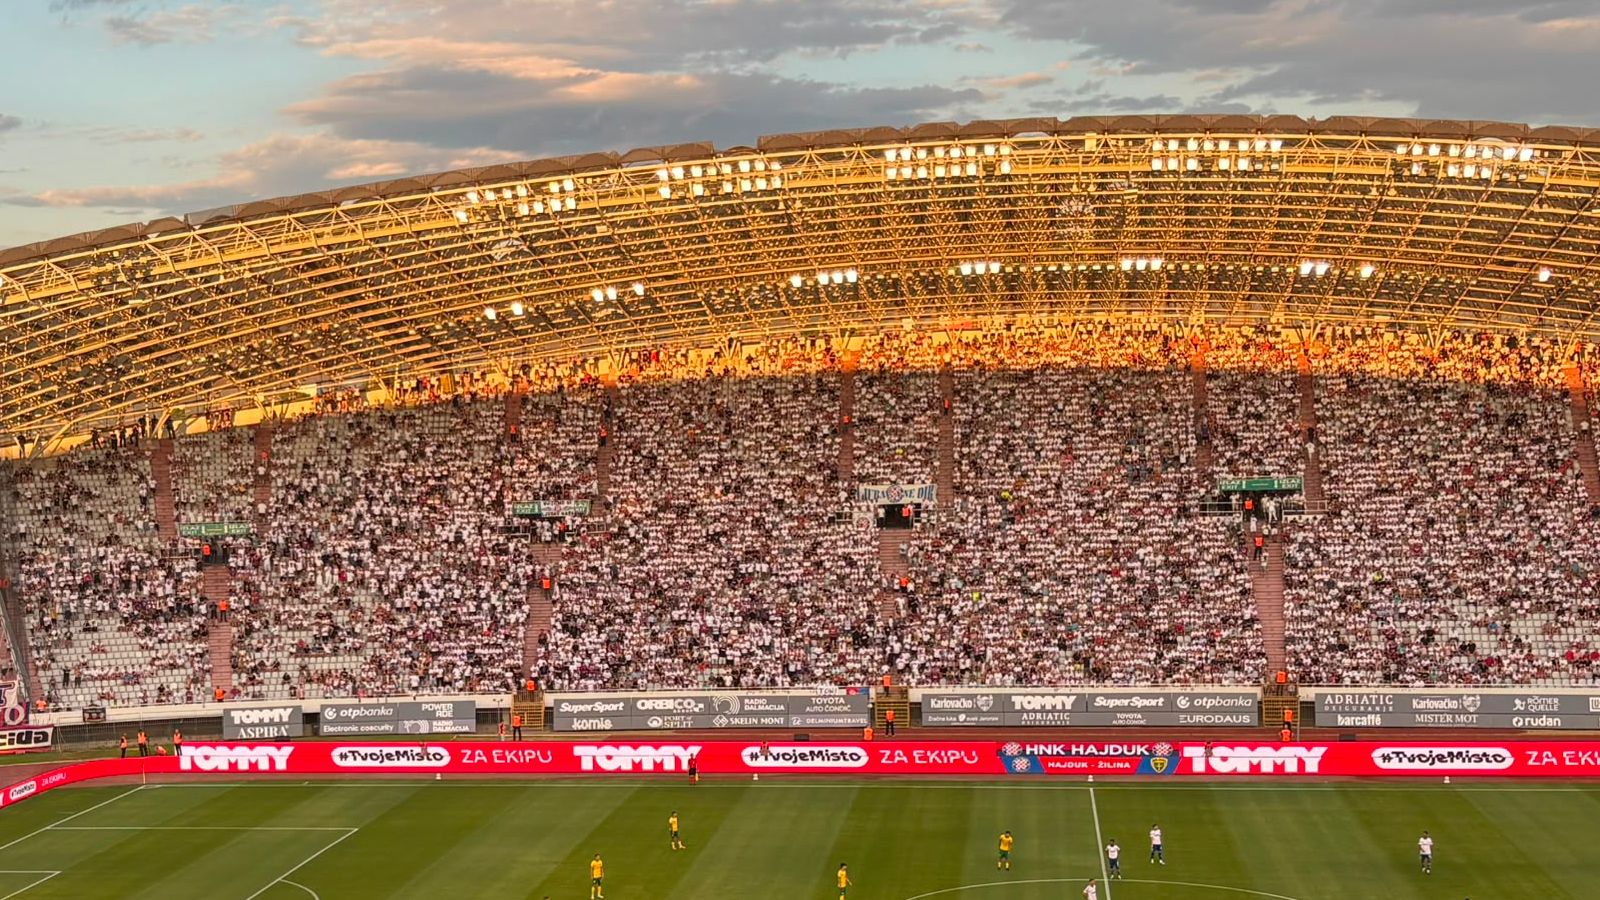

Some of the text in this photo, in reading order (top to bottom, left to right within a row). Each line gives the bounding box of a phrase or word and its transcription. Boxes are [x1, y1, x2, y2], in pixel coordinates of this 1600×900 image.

[636, 698, 696, 710] ORBICO
[1011, 696, 1077, 710] TOMMY
[1094, 696, 1165, 708] SuperSport
[1194, 696, 1252, 708] otpbanka
[1324, 694, 1394, 704] ADRIATIC
[560, 702, 625, 714] SuperSport
[231, 708, 294, 724] TOMMY
[1022, 712, 1070, 720] ADRIATIC
[1179, 714, 1250, 724] EURODAUS
[1415, 713, 1454, 723] MISTER
[1525, 714, 1561, 726] rudan
[238, 725, 288, 738] ASPIRA
[1026, 744, 1150, 756] HNK HAJDUK
[180, 746, 295, 770] TOMMY
[339, 750, 444, 764] #TvojeMisto
[461, 750, 553, 764] ZA EKIPU
[574, 746, 702, 770] TOMMY
[880, 750, 979, 764] ZA EKIPU
[1183, 746, 1328, 772] TOMMY
[1382, 750, 1506, 766] #TvojeMisto
[1525, 750, 1558, 766] ZA
